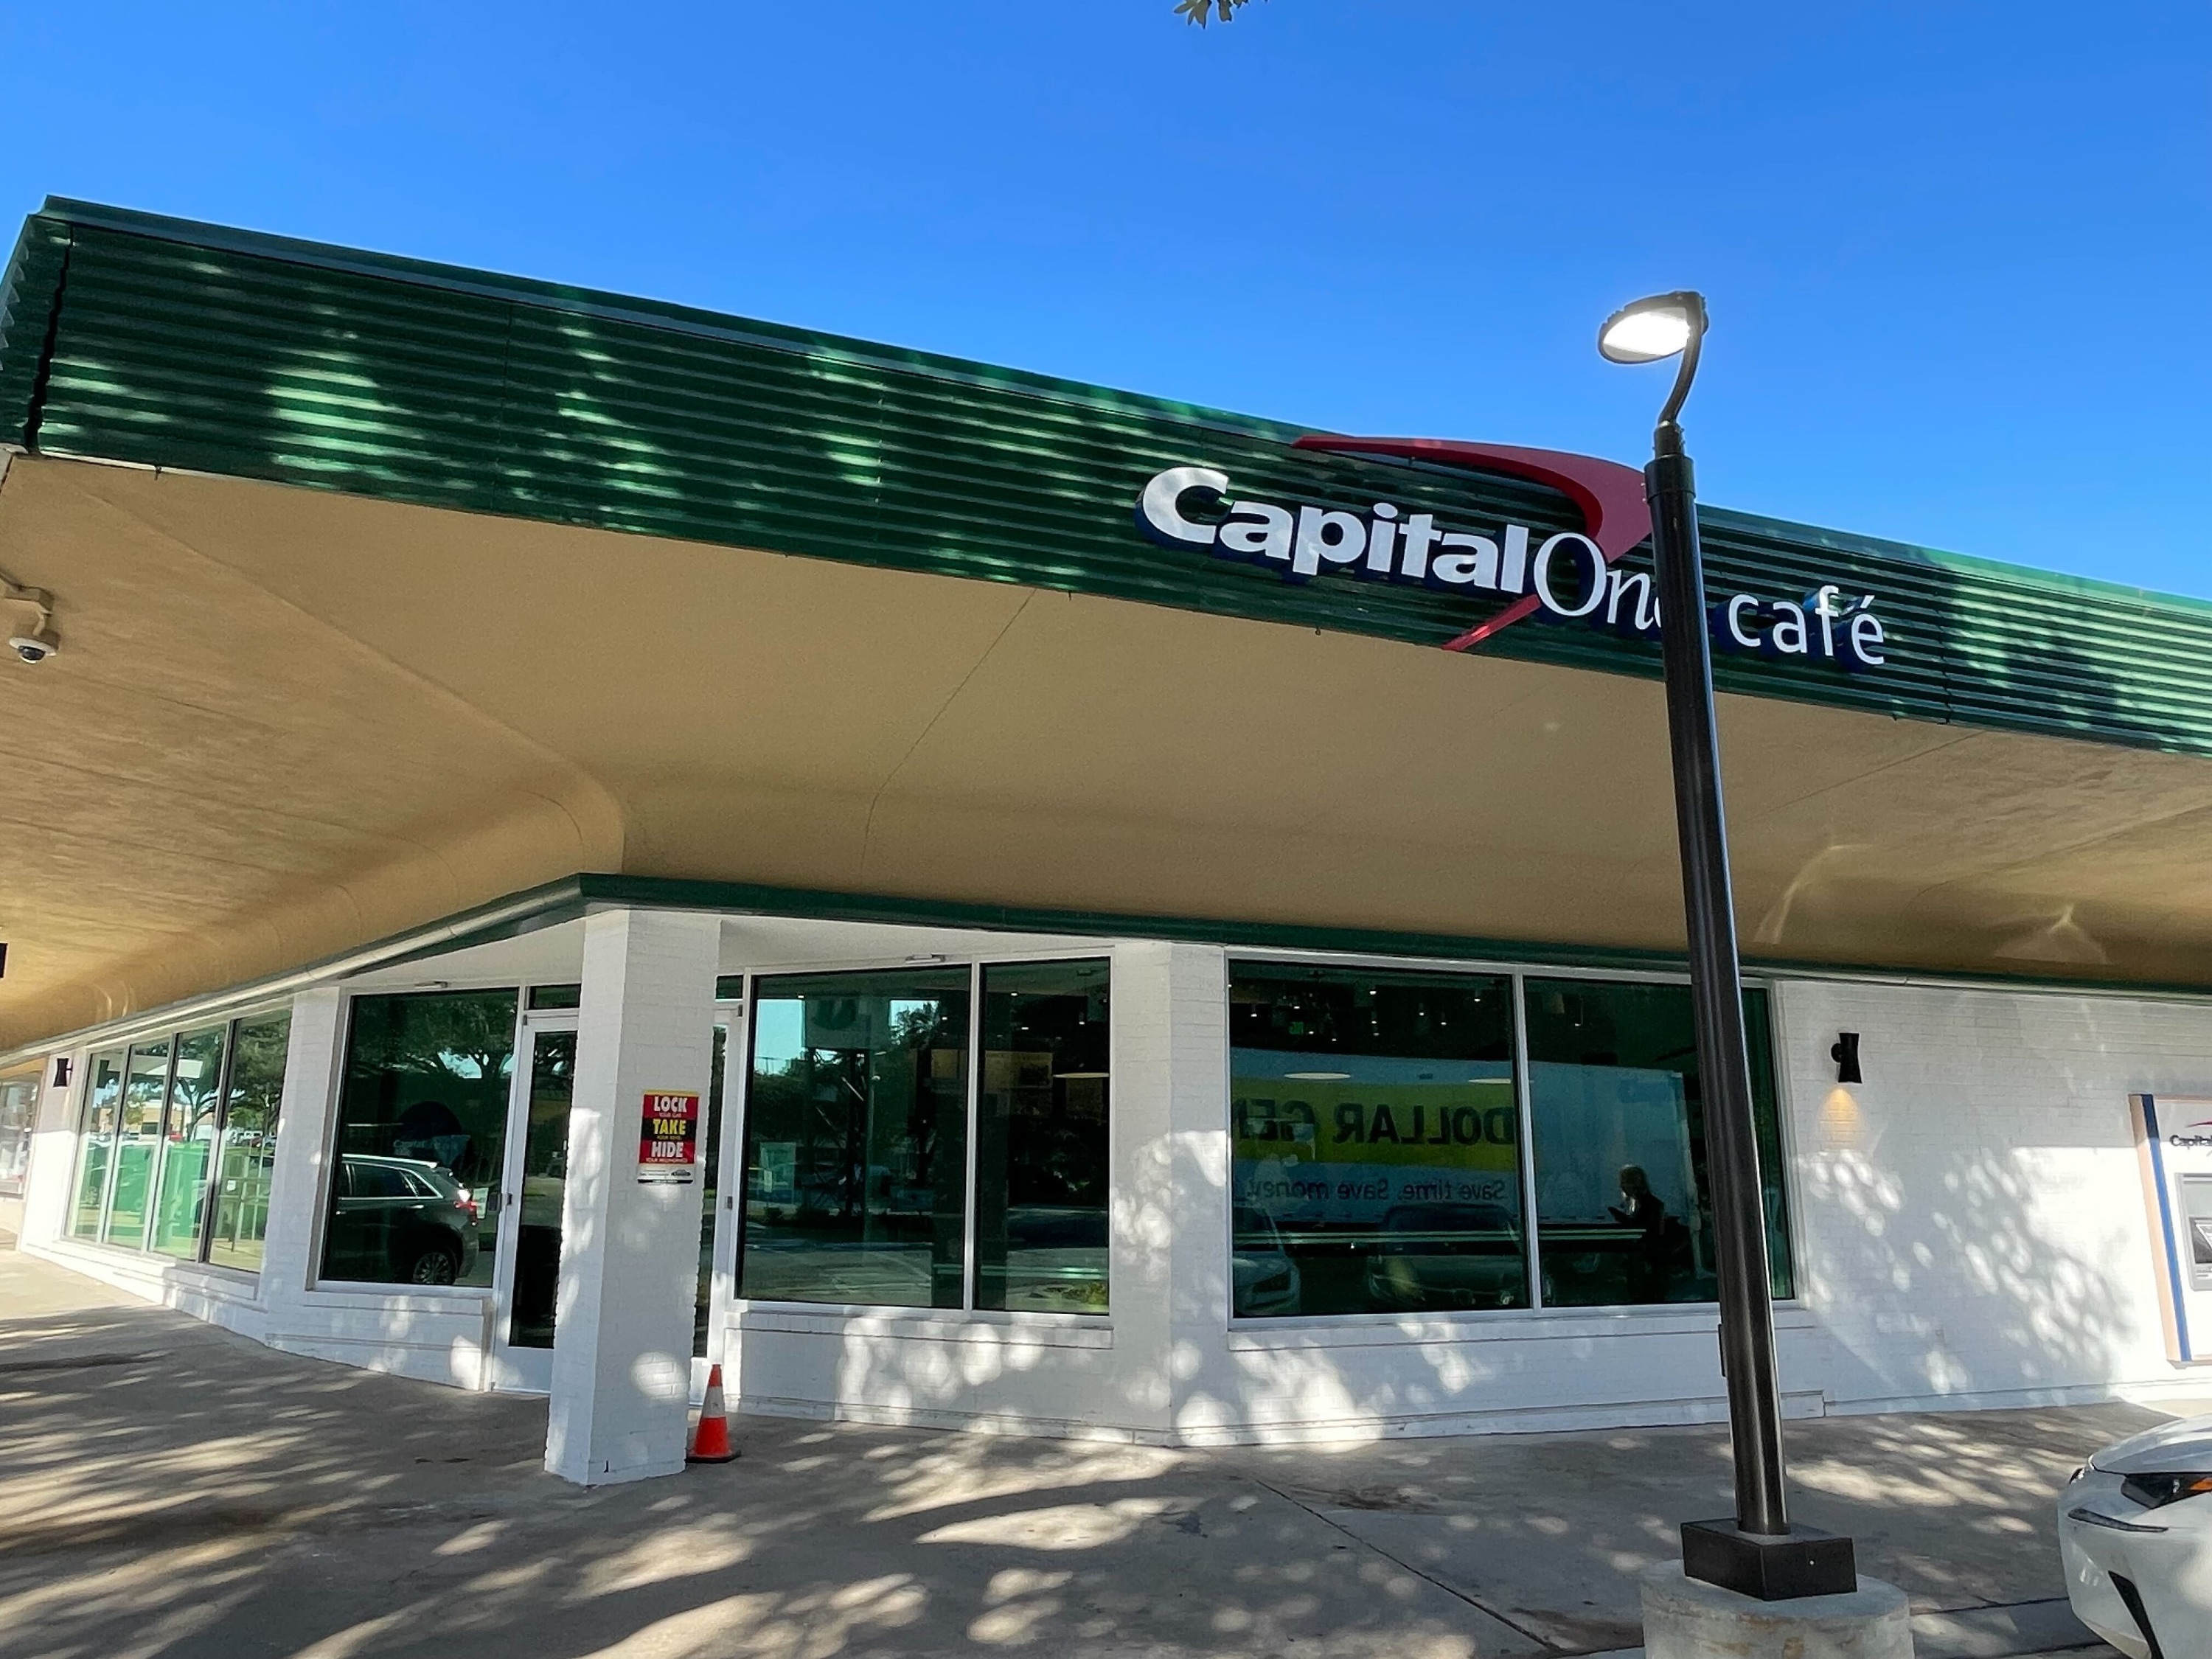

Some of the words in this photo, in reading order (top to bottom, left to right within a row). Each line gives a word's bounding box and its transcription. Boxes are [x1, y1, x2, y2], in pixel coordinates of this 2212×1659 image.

[1141, 466, 1530, 594] Capital
[1534, 532, 1661, 630] On
[1728, 585, 1885, 665] café
[653, 1096, 688, 1113] LOCK
[653, 1118, 686, 1135] TAKE
[651, 1141, 684, 1158] HIDE
